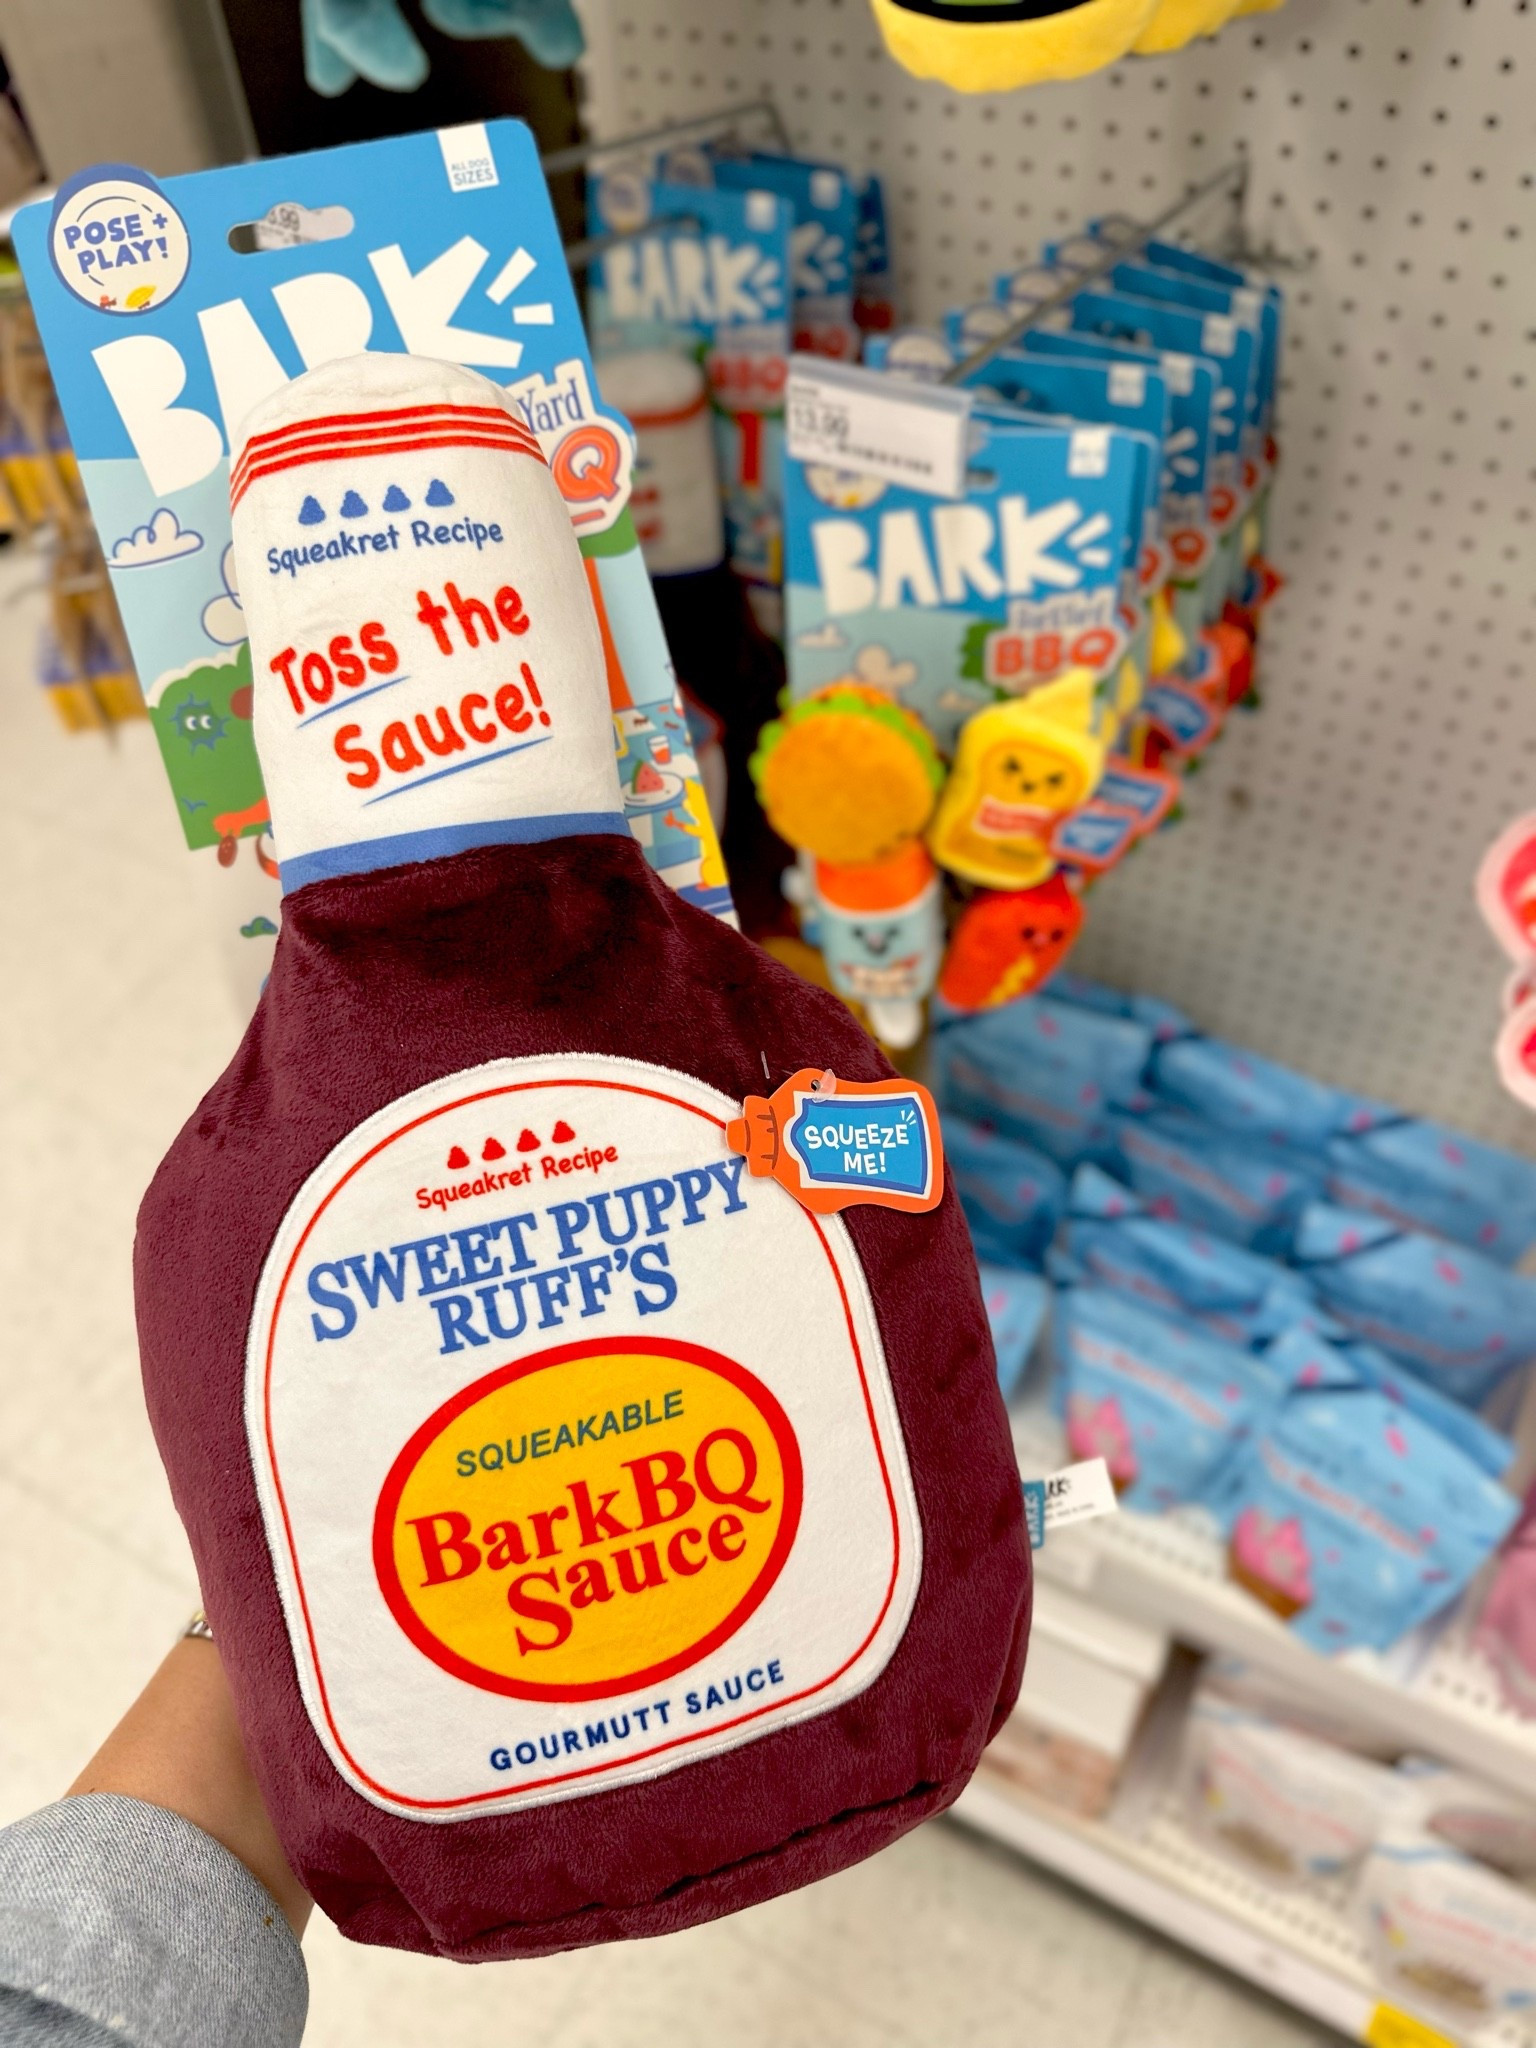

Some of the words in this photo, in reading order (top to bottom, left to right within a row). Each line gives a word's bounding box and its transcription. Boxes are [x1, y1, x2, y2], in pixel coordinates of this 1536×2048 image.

[453, 168, 494, 186] SIZES
[63, 214, 144, 250] POSE
[77, 236, 168, 275] PLAY!
[91, 236, 523, 497] BARK
[517, 377, 586, 436] Yard
[267, 525, 400, 577] Squeakret
[411, 517, 503, 550] Recipe
[812, 496, 1084, 616] BARK
[269, 621, 399, 716] Toss
[417, 582, 530, 656] the
[333, 662, 552, 789] Sauce!
[415, 1166, 532, 1210] Squeakret
[544, 1142, 618, 1180] Recipe
[804, 1123, 909, 1150] SQUEEZE
[843, 1151, 887, 1176] ME!
[307, 1213, 537, 1341] SWEET
[548, 1156, 750, 1260] PUPPY
[429, 1241, 679, 1356] RUFF'S
[456, 1390, 685, 1478] SQUEAKABLE
[507, 1512, 747, 1657] Sauce
[489, 1701, 671, 1771] GOURMUTT
[686, 1660, 785, 1715] SAUCE
